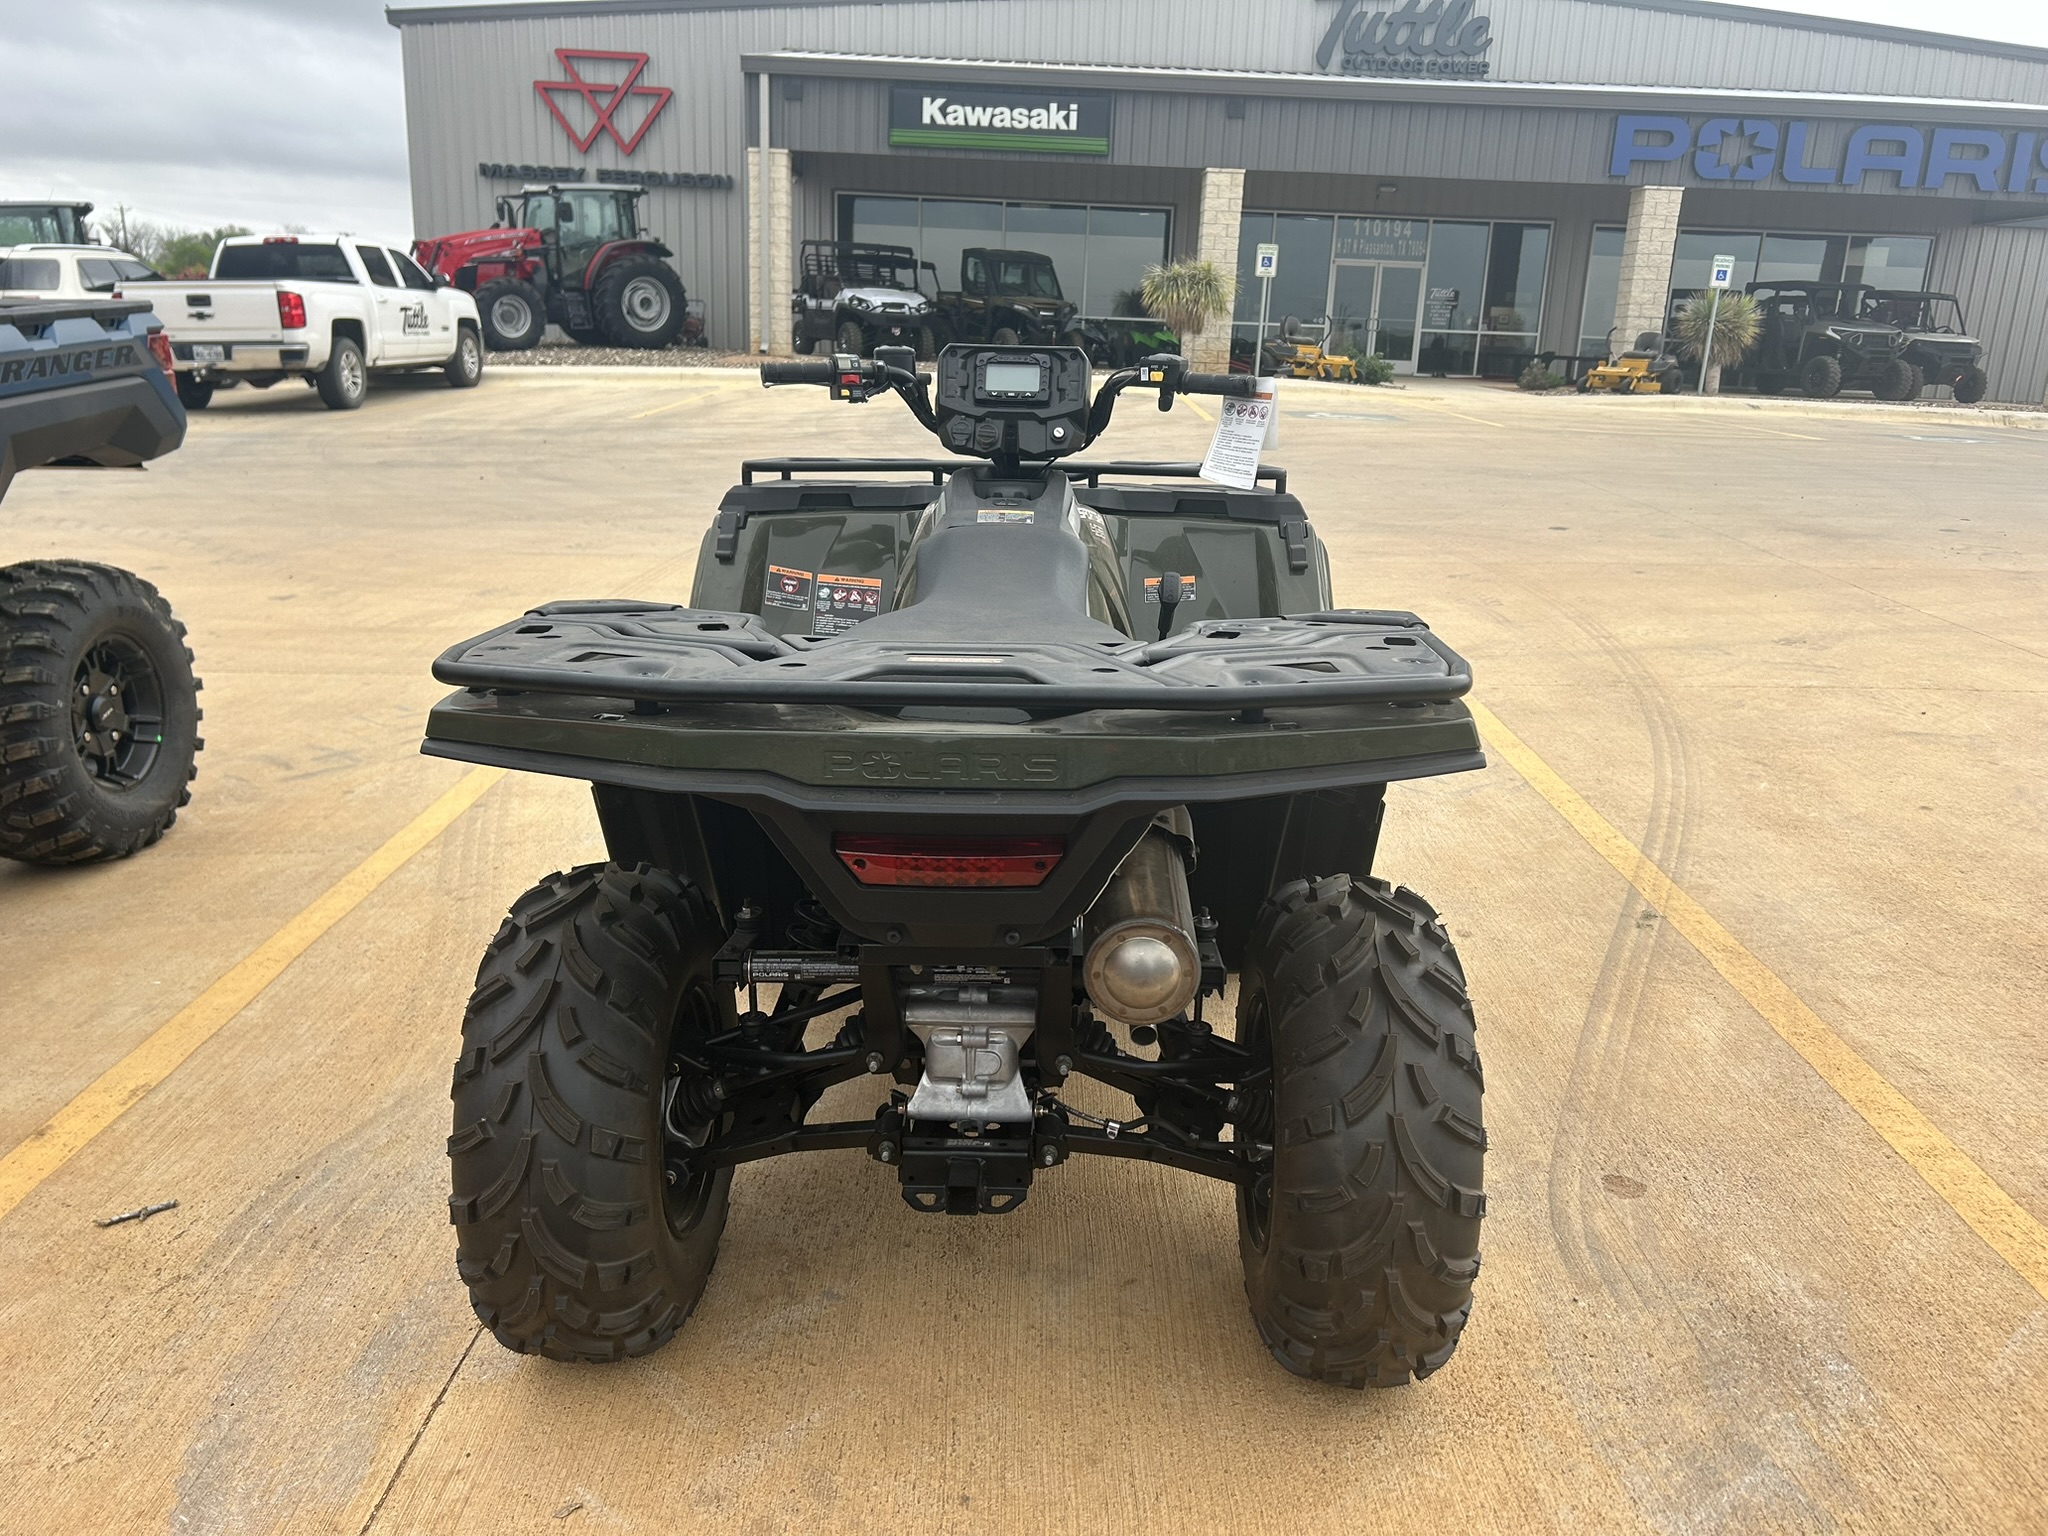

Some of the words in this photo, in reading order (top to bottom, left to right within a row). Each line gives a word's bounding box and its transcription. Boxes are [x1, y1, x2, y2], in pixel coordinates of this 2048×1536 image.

[1316, 0, 1493, 70] Tuttle
[1341, 57, 1424, 73] OUTDOOR
[1427, 60, 1490, 75] POWER
[922, 97, 1078, 130] Kawasaki
[1610, 114, 2048, 194] POLARI
[479, 162, 586, 182] MASSEY
[596, 168, 734, 189] FERGUSON
[1353, 218, 1412, 238] 110194
[1430, 288, 1455, 299] Tuttle
[400, 303, 429, 336] Tuttle
[0, 344, 134, 384] RANGER
[781, 568, 804, 577] WARNING
[824, 751, 1062, 781] POLARIS
